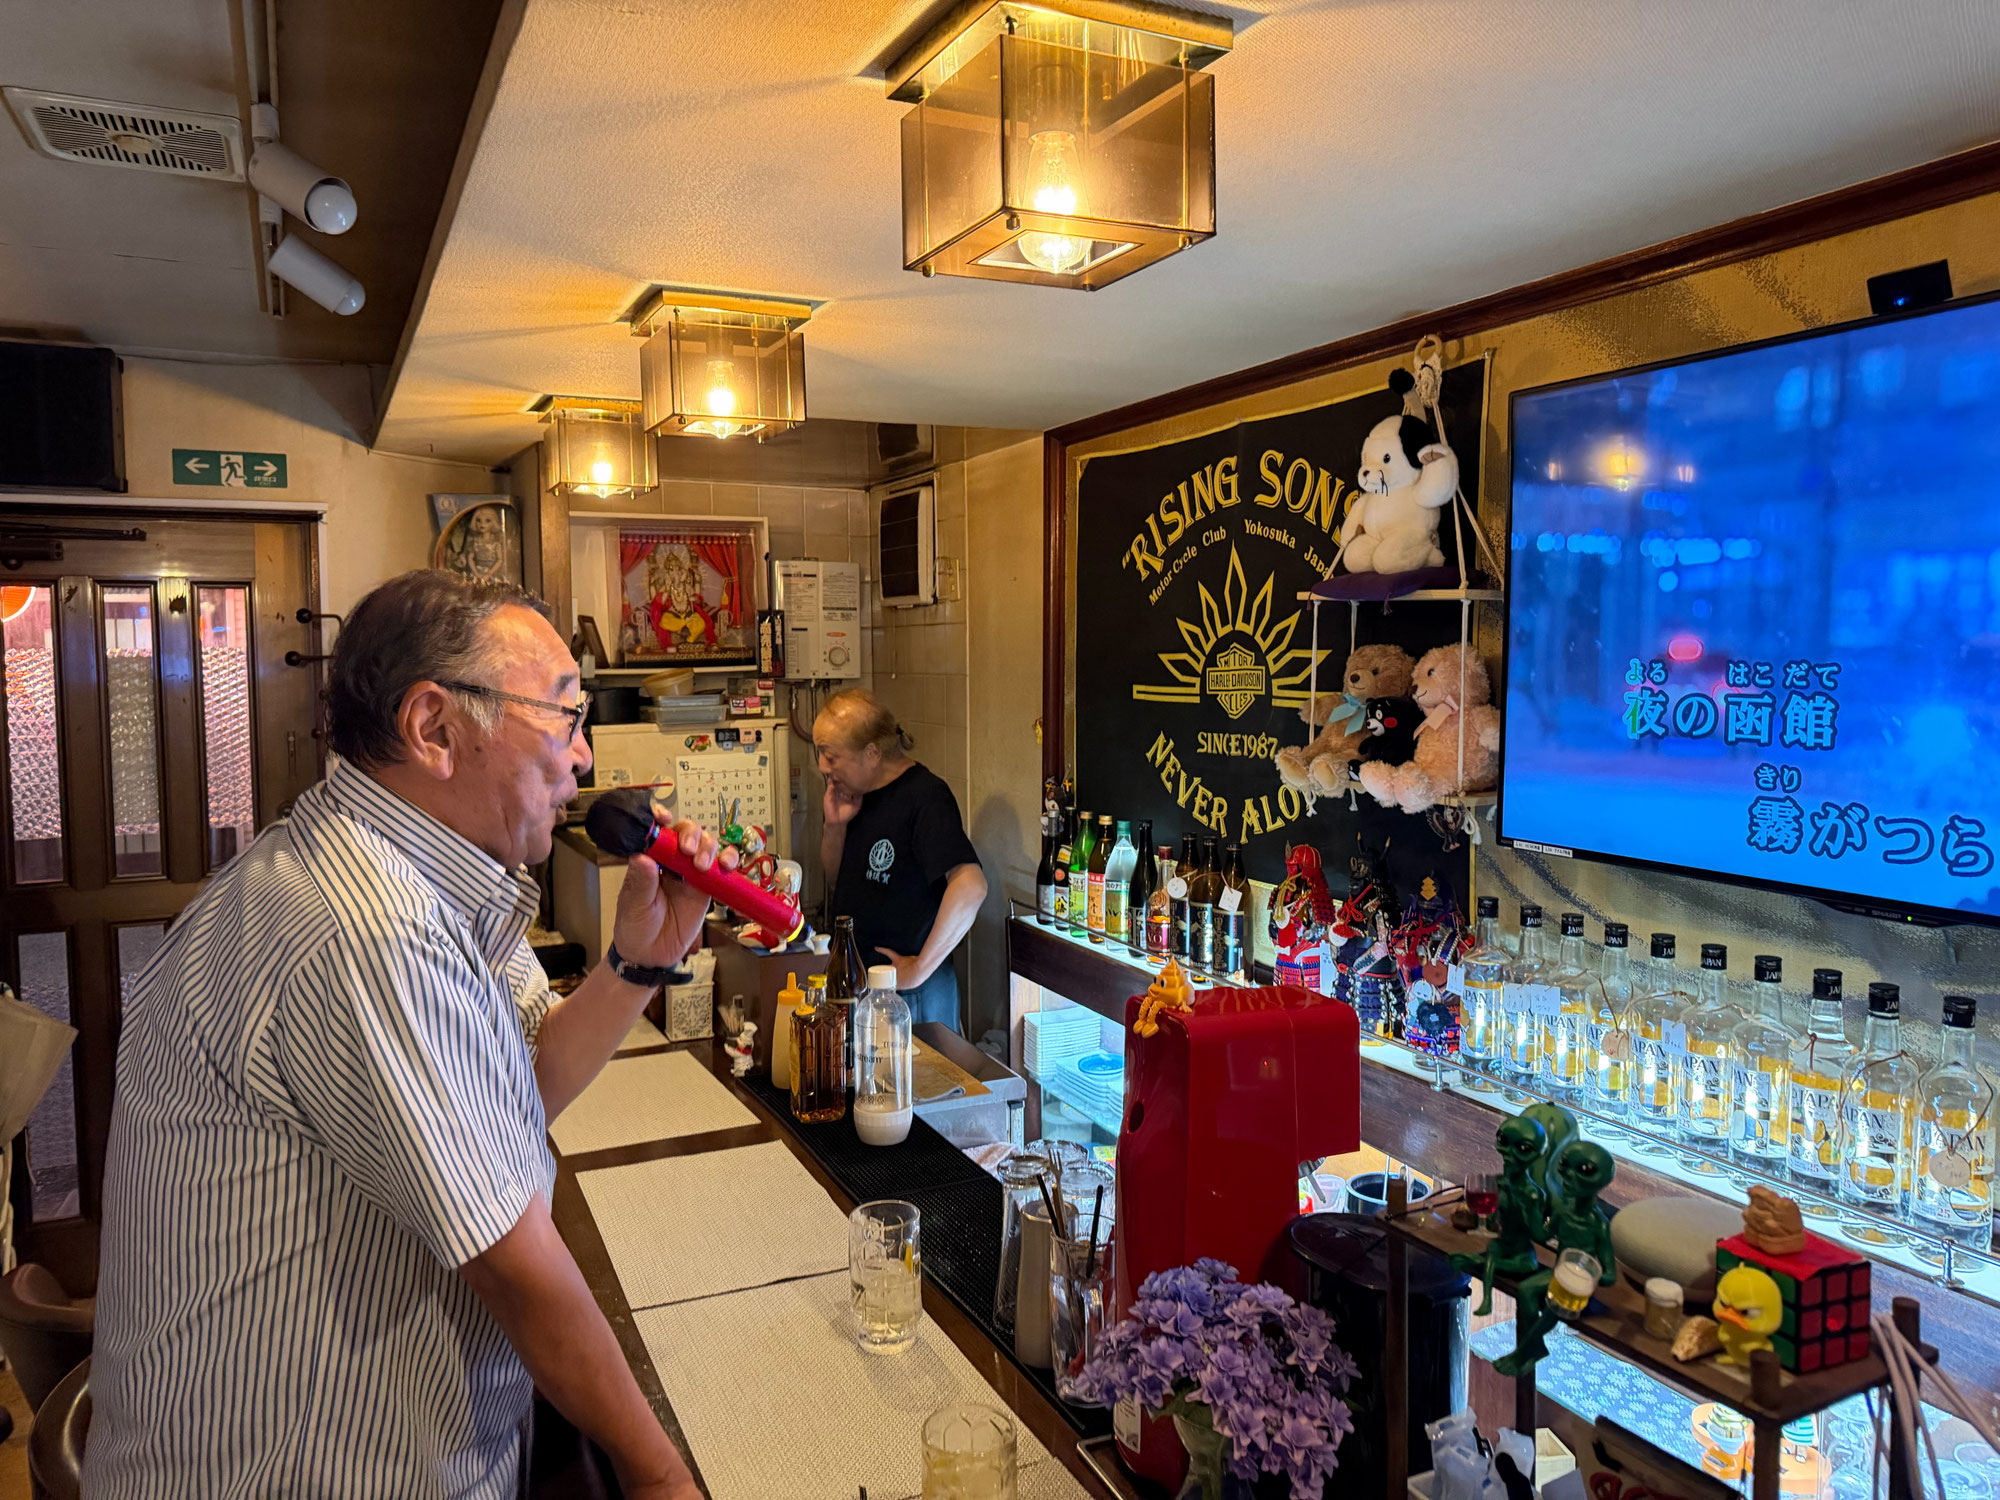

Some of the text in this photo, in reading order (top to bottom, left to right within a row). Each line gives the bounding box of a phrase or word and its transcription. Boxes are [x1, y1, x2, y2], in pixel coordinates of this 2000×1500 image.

[1148, 519, 1335, 606] Motor Cycle Club Yokosuka Japa
[1628, 660, 1666, 686] よる
[1626, 692, 1837, 748] 夜の函館
[682, 761, 690, 771] 6
[1756, 764, 1799, 792] きり
[1145, 730, 1229, 839] NEVER
[1750, 797, 1993, 876] 霧がつら
[1871, 910, 1902, 919] SHARP
[1937, 1207, 1951, 1219] 25
